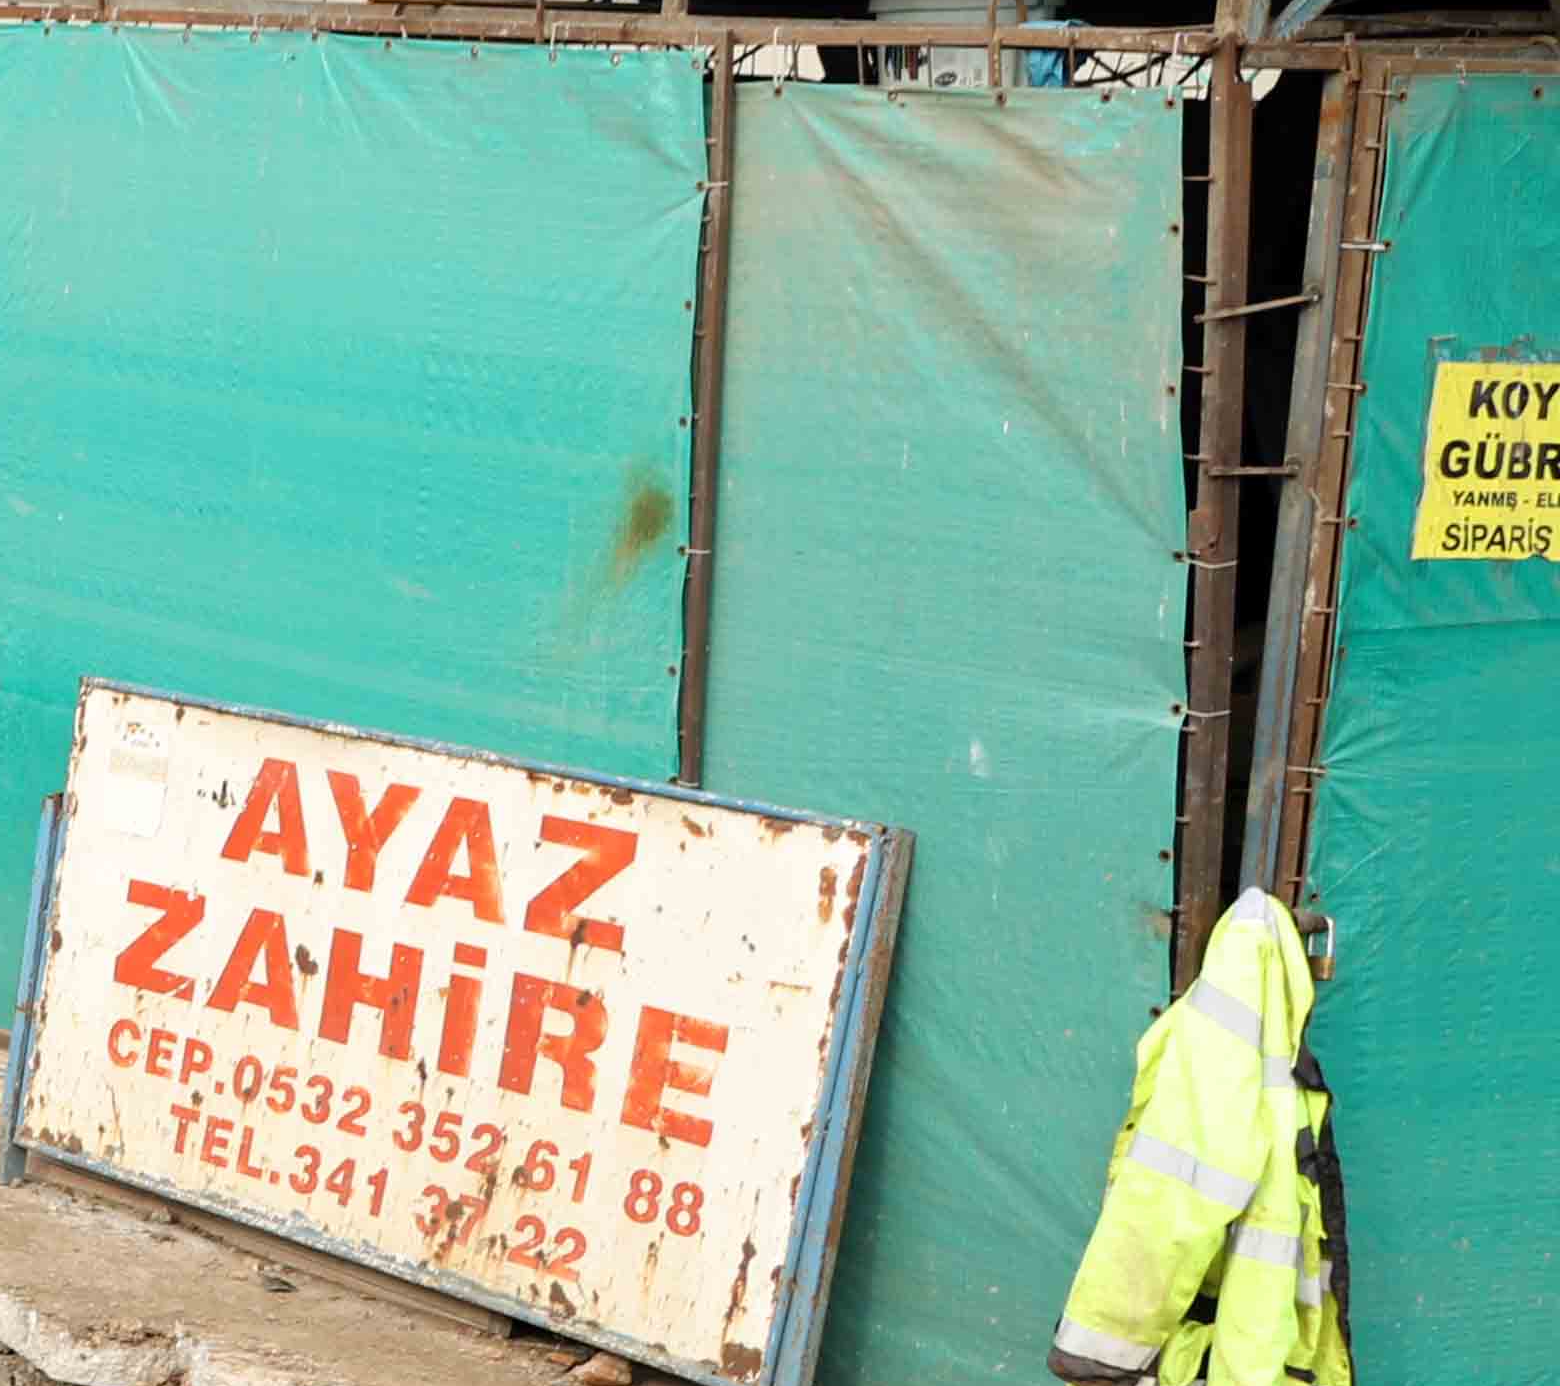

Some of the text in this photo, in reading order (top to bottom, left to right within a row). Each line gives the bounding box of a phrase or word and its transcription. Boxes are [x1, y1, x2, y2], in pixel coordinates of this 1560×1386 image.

[1468, 379, 1560, 421] KOY
[220, 756, 639, 953] AYAZ
[106, 1017, 705, 1238] CEP.0532 352 61 88
[169, 1102, 588, 1283] TEL.341 37 22
